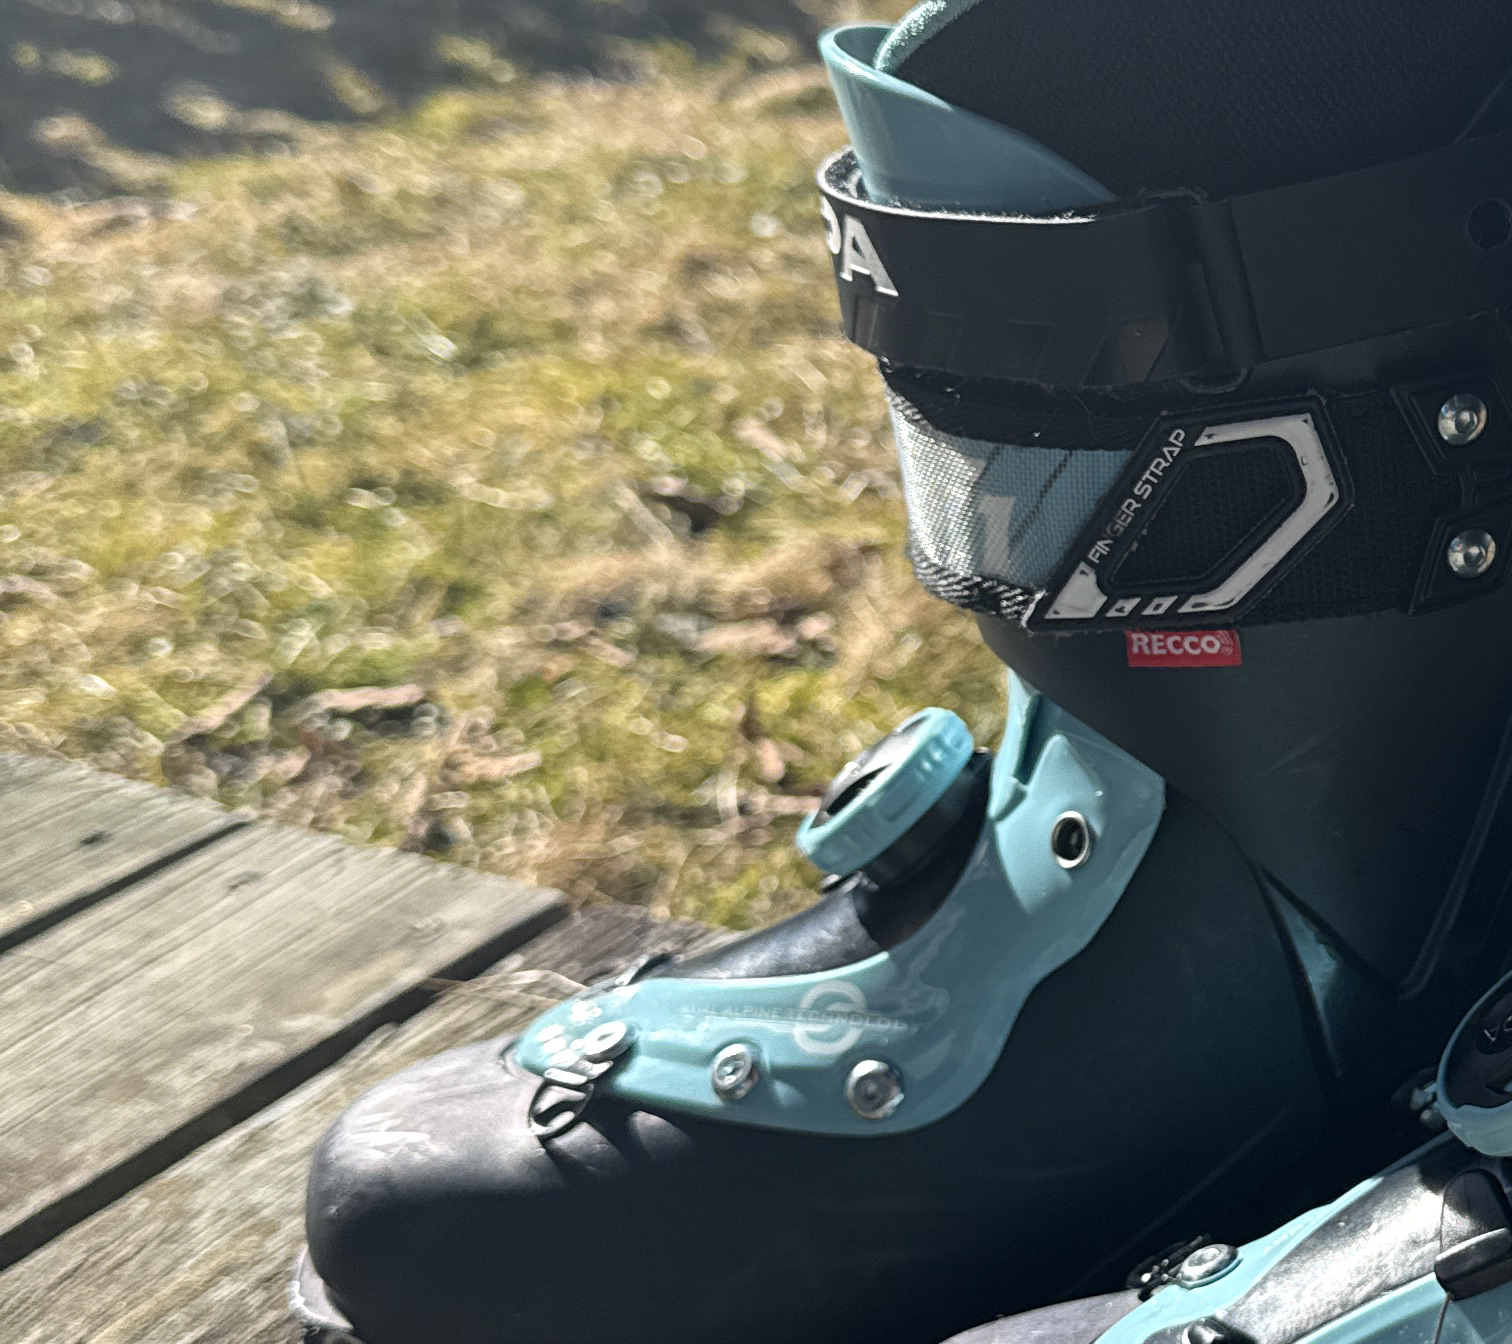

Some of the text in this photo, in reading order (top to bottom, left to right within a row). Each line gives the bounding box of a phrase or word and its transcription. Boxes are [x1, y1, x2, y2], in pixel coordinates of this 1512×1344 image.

[1088, 428, 1186, 564] FINGER STRAP
[1131, 632, 1222, 655] RECCO
